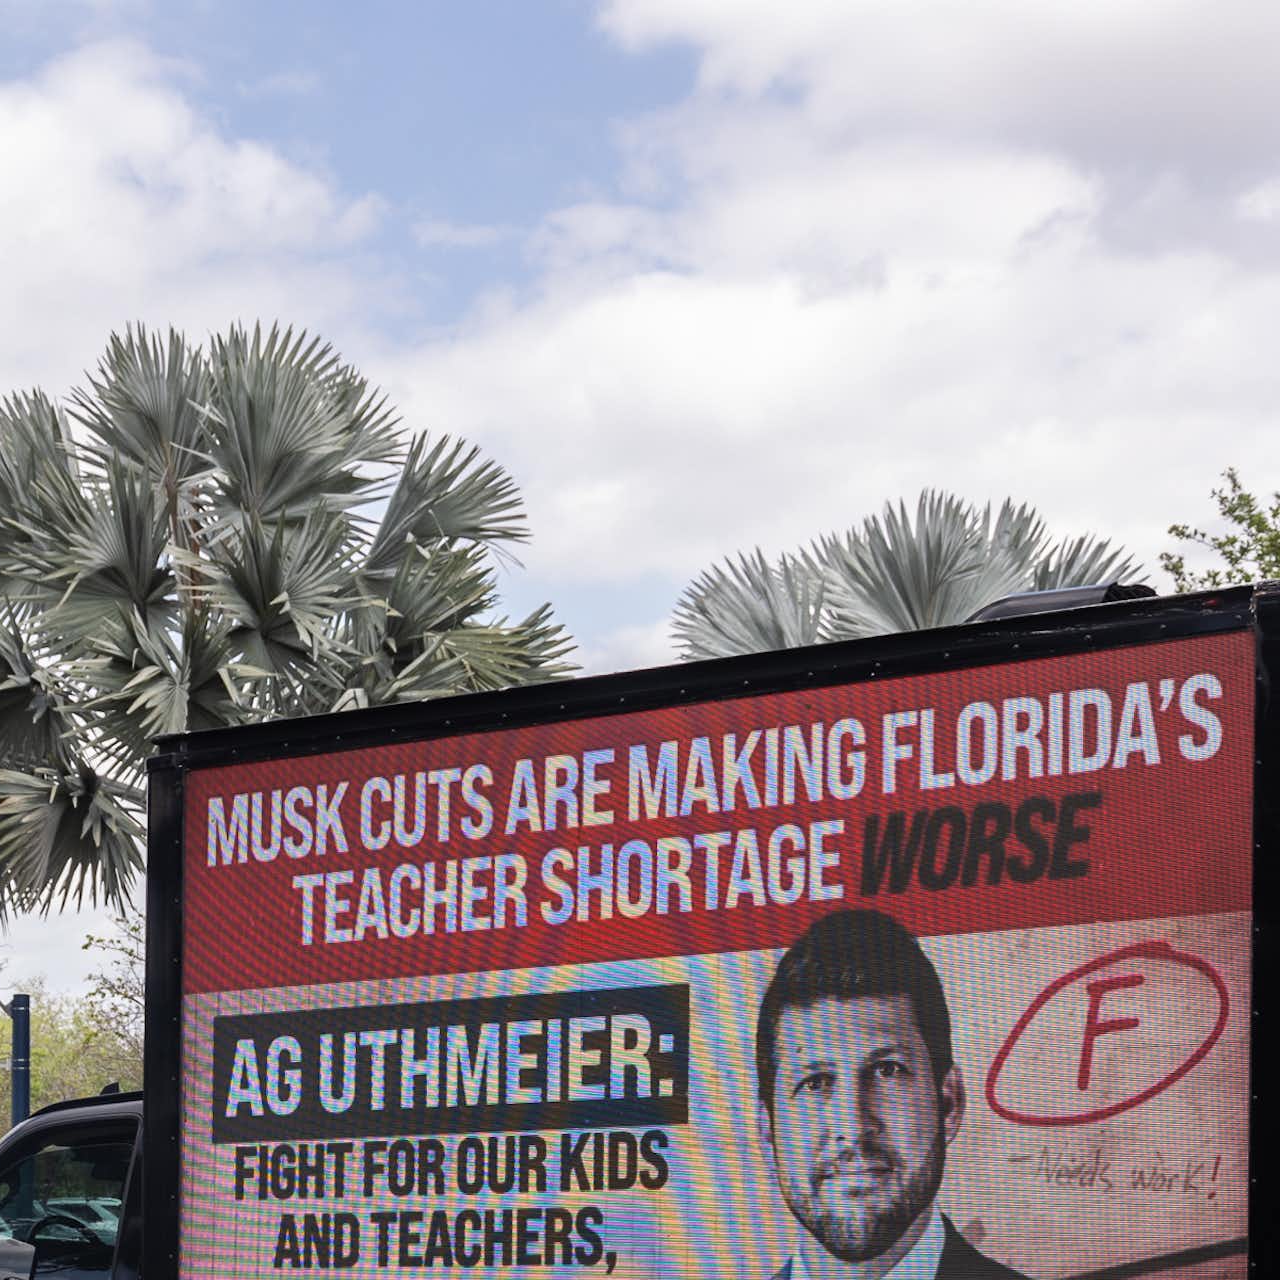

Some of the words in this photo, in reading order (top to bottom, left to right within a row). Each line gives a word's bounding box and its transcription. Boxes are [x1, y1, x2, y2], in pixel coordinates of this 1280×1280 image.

[207, 781, 349, 867] MUSK
[360, 764, 494, 851] CUTS
[504, 748, 615, 835] ARE
[628, 718, 866, 821] MAKING
[882, 673, 1223, 794] FLORIDA'S
[292, 853, 528, 946] TEACHER
[540, 819, 845, 925] SHORTAGE
[860, 793, 1103, 897] WORSE
[225, 1034, 302, 1119] AG
[319, 1013, 675, 1114] UTHMEIER:
[1077, 974, 1144, 1091] F
[234, 1141, 354, 1201] FIGHT
[363, 1137, 445, 1197] FOR
[456, 1133, 547, 1195] OUR
[560, 1129, 669, 1193] KIDS
[274, 1211, 360, 1269] AND
[370, 1206, 617, 1274] TEACHERS,
